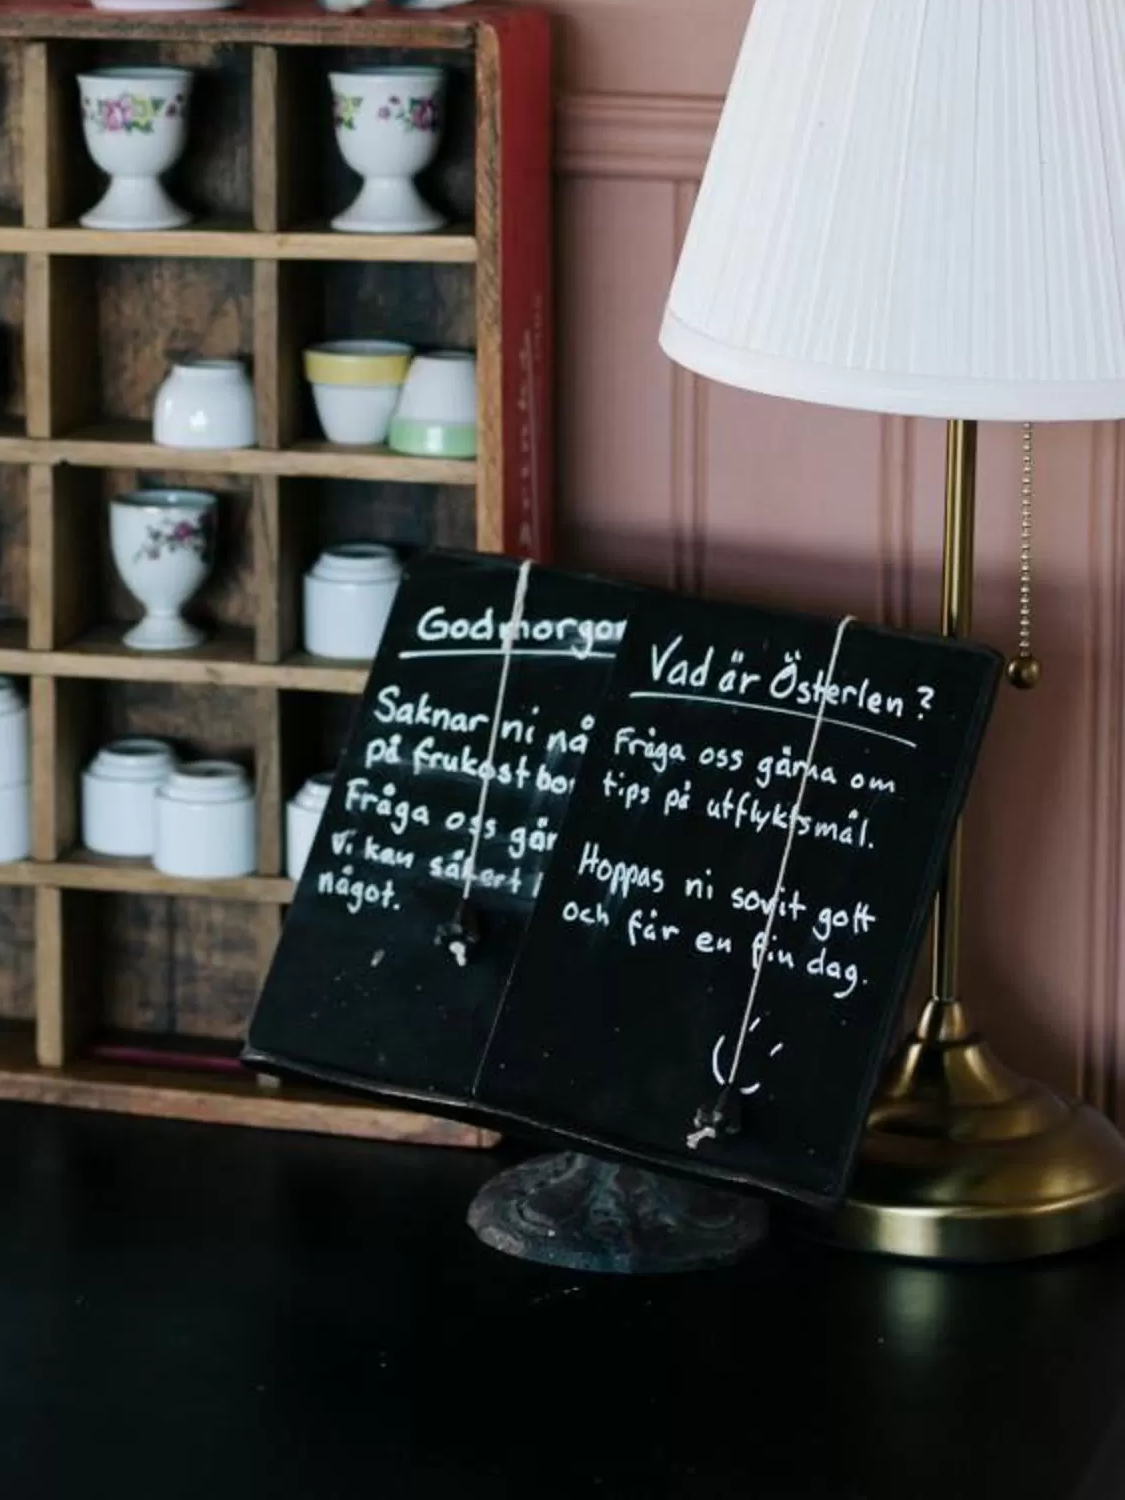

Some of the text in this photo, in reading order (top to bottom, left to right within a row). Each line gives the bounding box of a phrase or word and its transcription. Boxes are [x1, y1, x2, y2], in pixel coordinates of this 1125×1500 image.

[651, 635, 715, 689] Vad
[718, 649, 761, 695] är
[373, 685, 489, 732] Saknar
[501, 706, 539, 744] ni
[365, 734, 402, 769] på
[614, 726, 896, 794] Fråga oss gärna om
[345, 778, 430, 835] Fråga
[445, 811, 497, 840] oss
[602, 771, 874, 849] tips på utflyktsmål.
[364, 835, 414, 869] kan
[318, 865, 401, 914] något.
[577, 841, 665, 899] Hoppas
[685, 868, 714, 900] ni
[731, 886, 806, 921] sovit
[812, 902, 877, 942] gott
[628, 909, 680, 947] får
[695, 931, 732, 953] en
[806, 947, 869, 999] dag.
